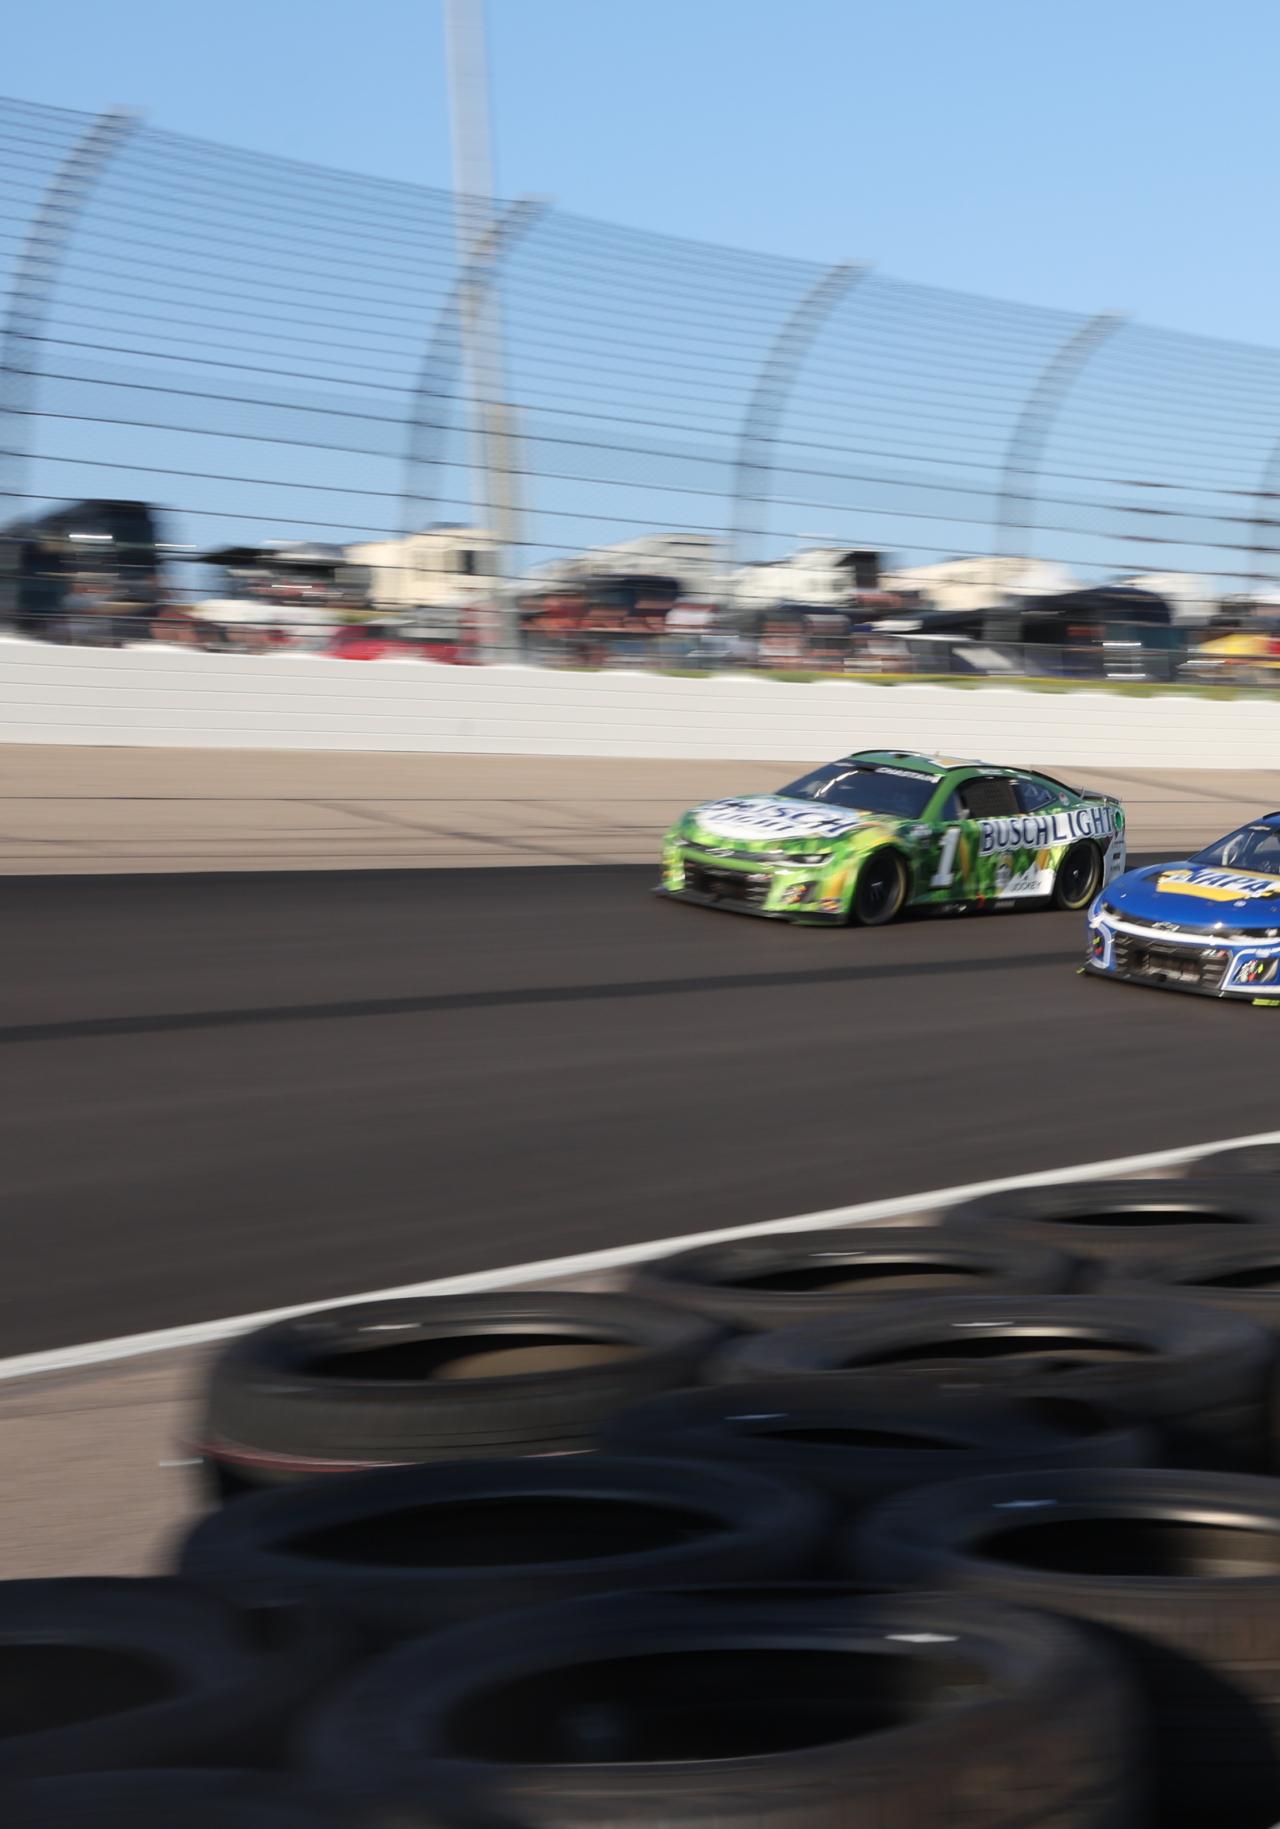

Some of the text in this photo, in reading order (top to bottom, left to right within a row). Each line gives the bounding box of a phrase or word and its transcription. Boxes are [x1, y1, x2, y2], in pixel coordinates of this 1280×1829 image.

[982, 807, 1113, 852] BUSCH LIGHT
[930, 826, 961, 887] 1
[1185, 867, 1275, 893] NAPA
